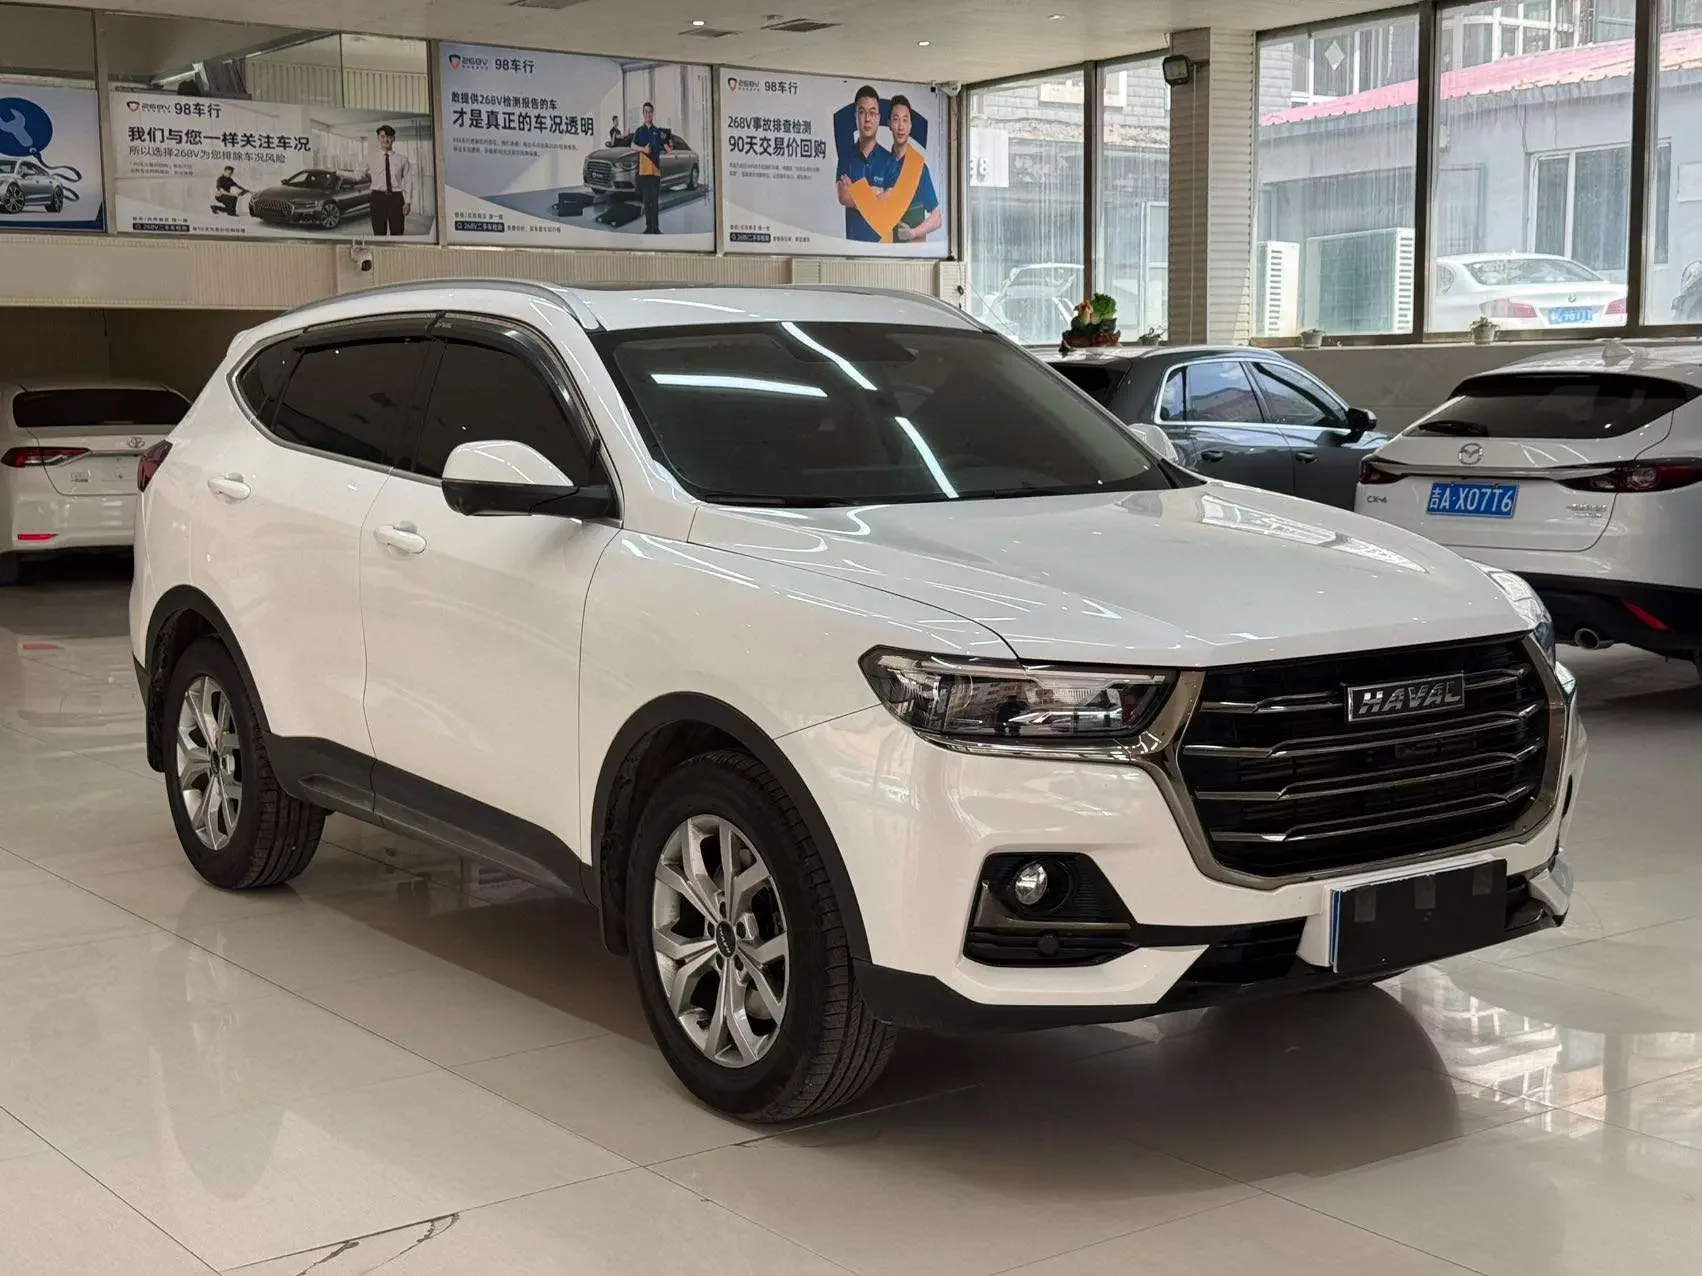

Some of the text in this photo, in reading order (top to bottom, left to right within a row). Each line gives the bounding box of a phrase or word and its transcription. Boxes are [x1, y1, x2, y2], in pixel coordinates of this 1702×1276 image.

[495, 58, 535, 74] 98车行
[764, 81, 798, 95] 98车行
[174, 102, 222, 119] 98车行
[451, 92, 558, 110] 敢提供268V检测报告的车
[452, 107, 595, 136] 才是真正的车况透明
[727, 115, 812, 135] 268V事故排查检测
[128, 126, 312, 152] 我们与您一样关注车况
[728, 134, 827, 159] 90天交易价回购
[128, 146, 288, 164] 所以选择268V为您排除车况风险
[1358, 680, 1461, 714] HAVAL
